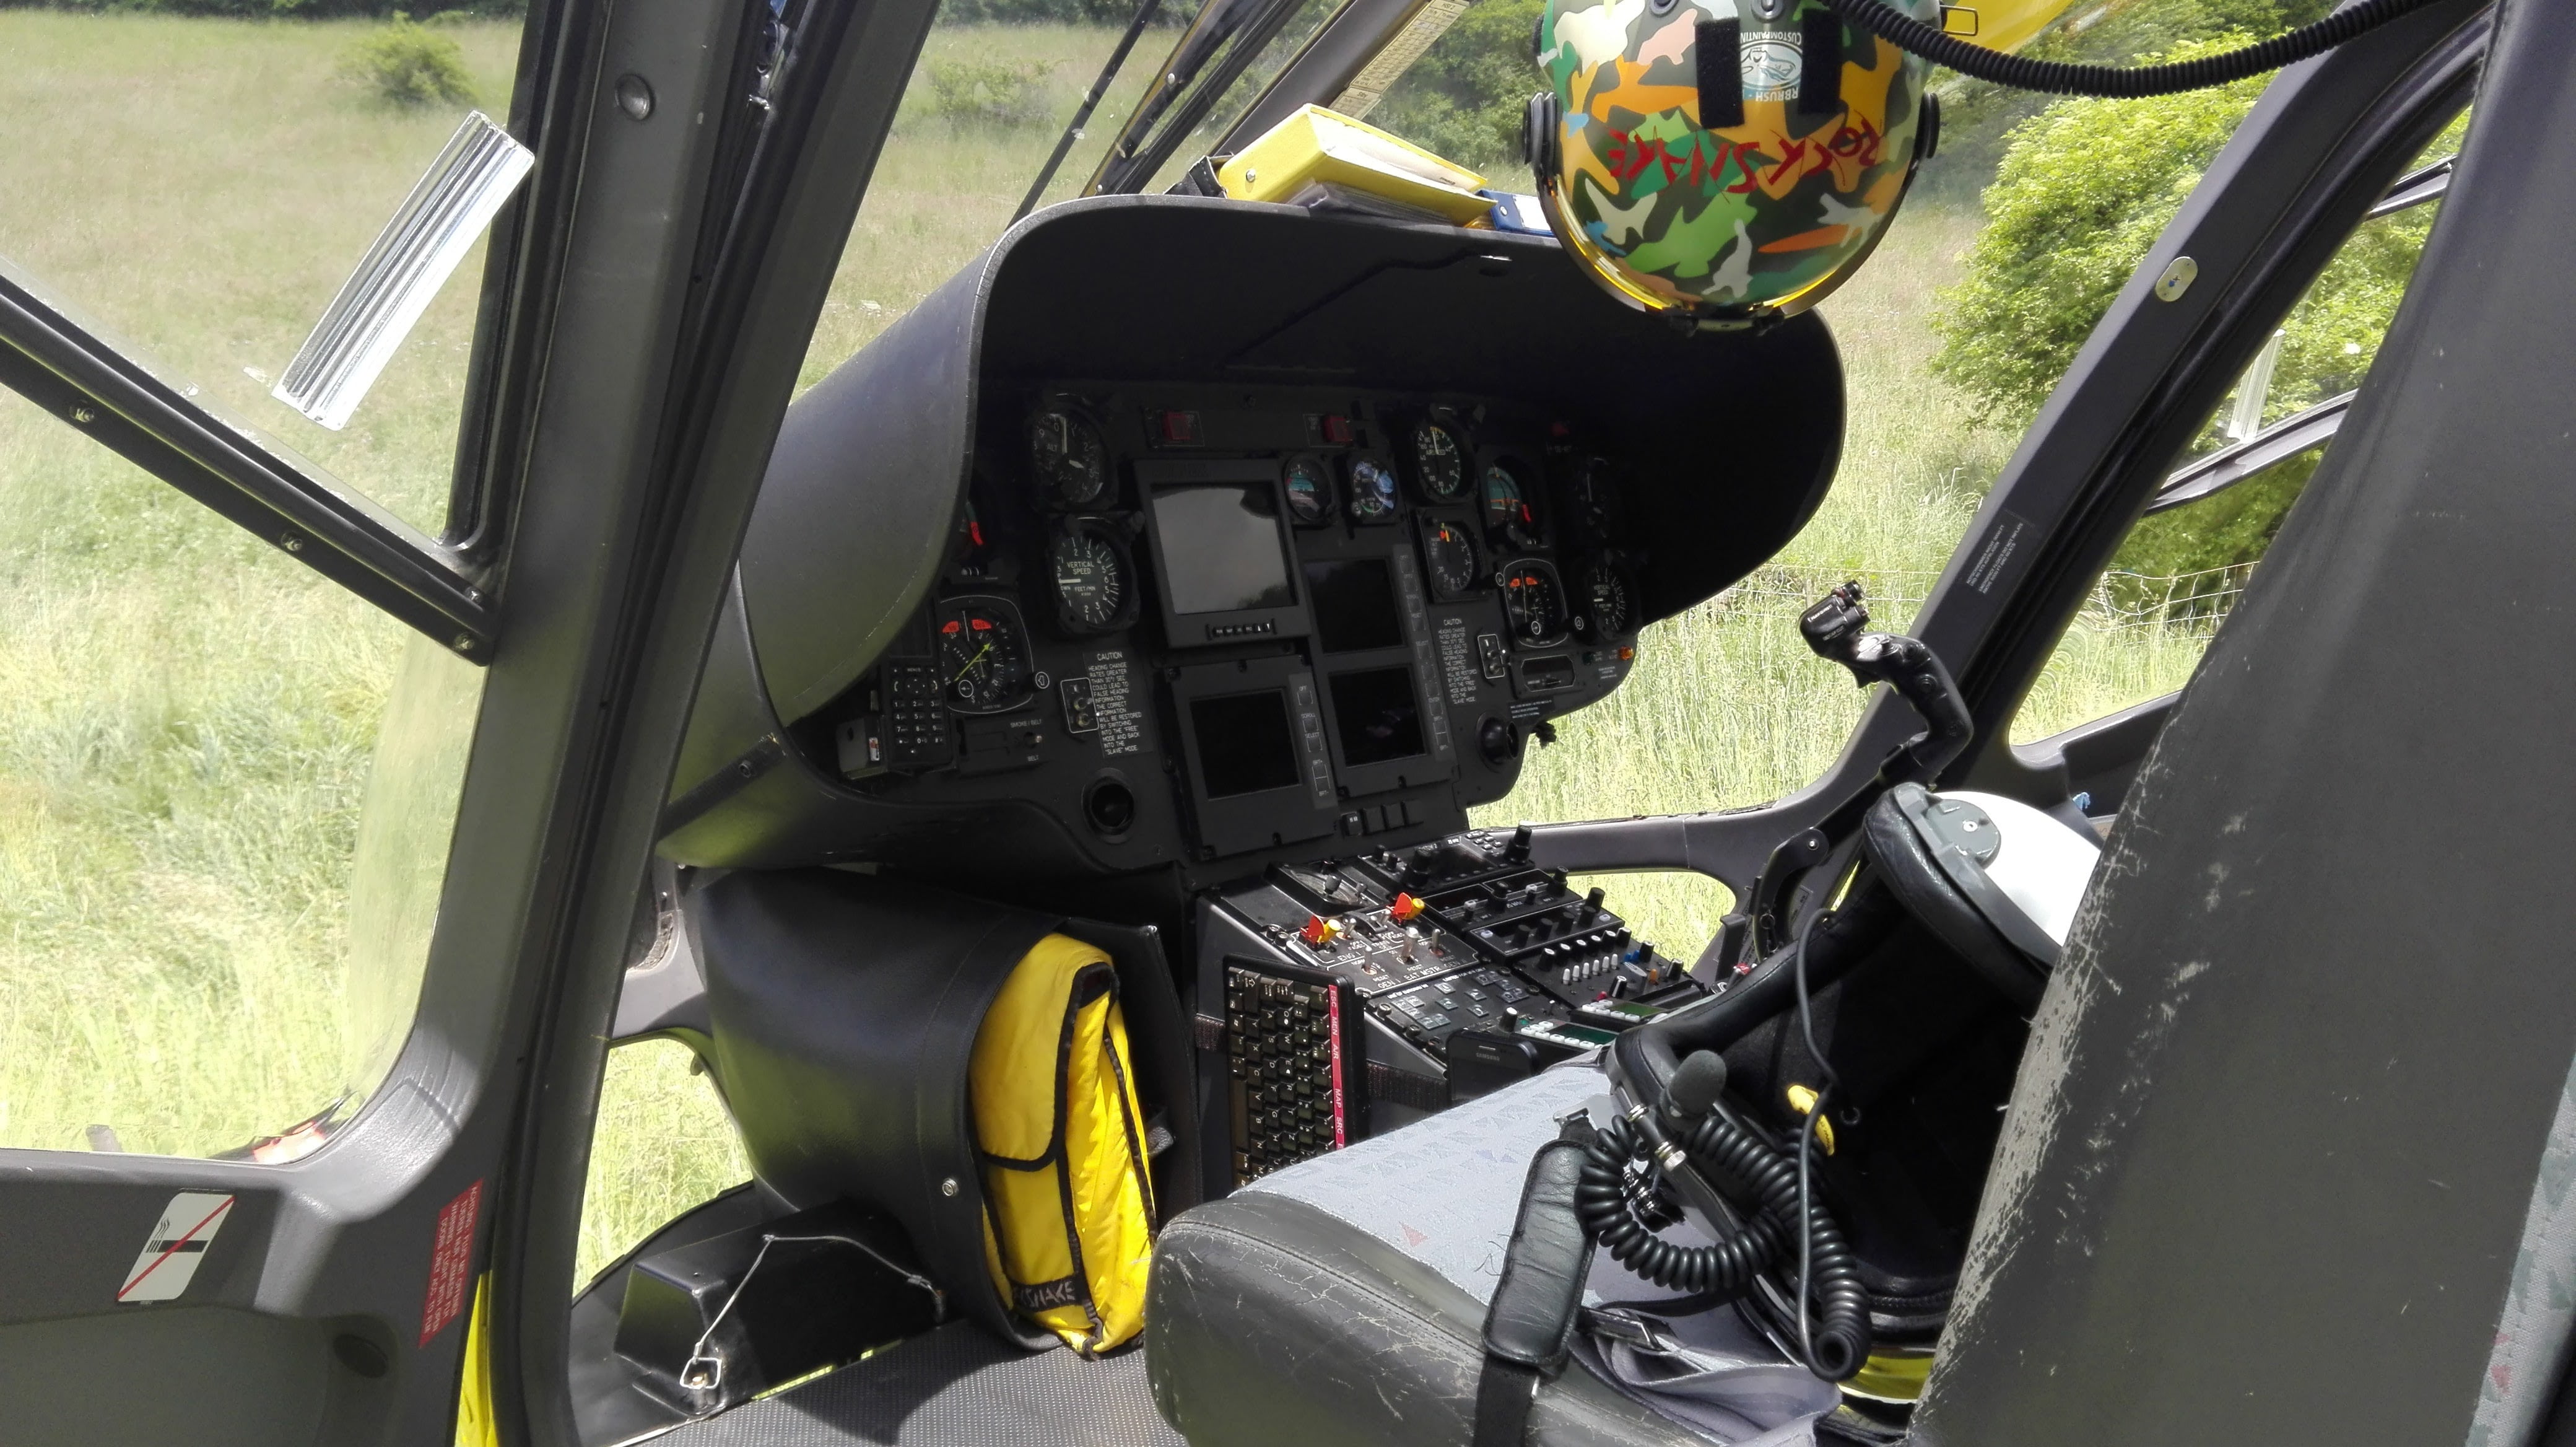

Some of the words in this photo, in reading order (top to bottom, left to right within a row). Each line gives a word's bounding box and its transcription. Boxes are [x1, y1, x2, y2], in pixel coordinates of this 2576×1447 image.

[1741, 31, 1802, 45] CUSTOMPAINTIN
[1097, 652, 1123, 661] CAUTION
[1095, 695, 1124, 703] INFORMATION
[1338, 953, 1355, 961] ENG
[1420, 966, 1442, 977] MSTR
[1377, 980, 1396, 989] GEN
[1476, 1052, 1500, 1062] SAMSUNG
[438, 1217, 448, 1249] DOORS
[453, 1237, 461, 1256] NUR
[461, 1234, 469, 1258] FLUG
[441, 1251, 450, 1280] FLIGHT
[437, 1282, 445, 1306] WITH
[427, 1300, 435, 1313] TO
[433, 1307, 441, 1332] OPEN
